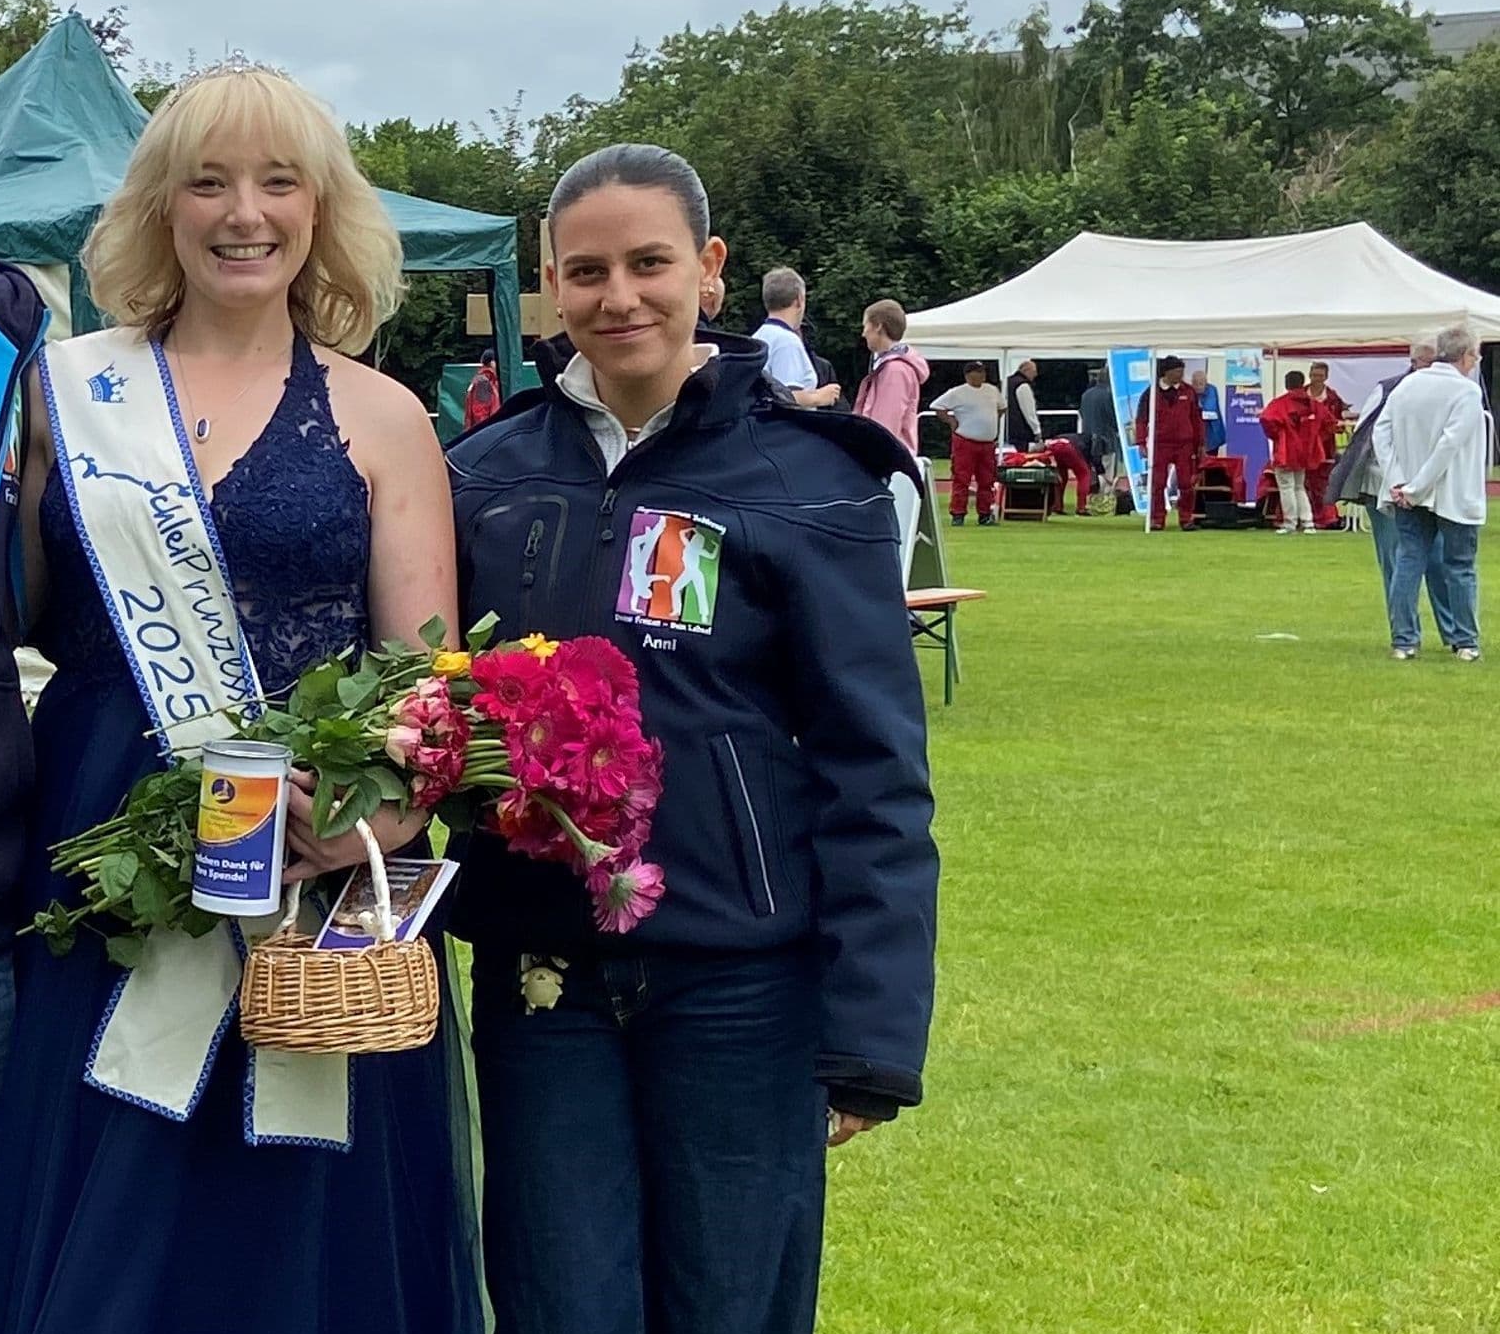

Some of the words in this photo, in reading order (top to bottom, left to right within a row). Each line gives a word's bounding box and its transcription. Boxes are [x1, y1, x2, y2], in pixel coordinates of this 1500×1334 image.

[642, 632, 678, 651] Anni
[119, 584, 214, 721] 2025
[221, 859, 248, 871] Dank
[249, 860, 266, 871] für
